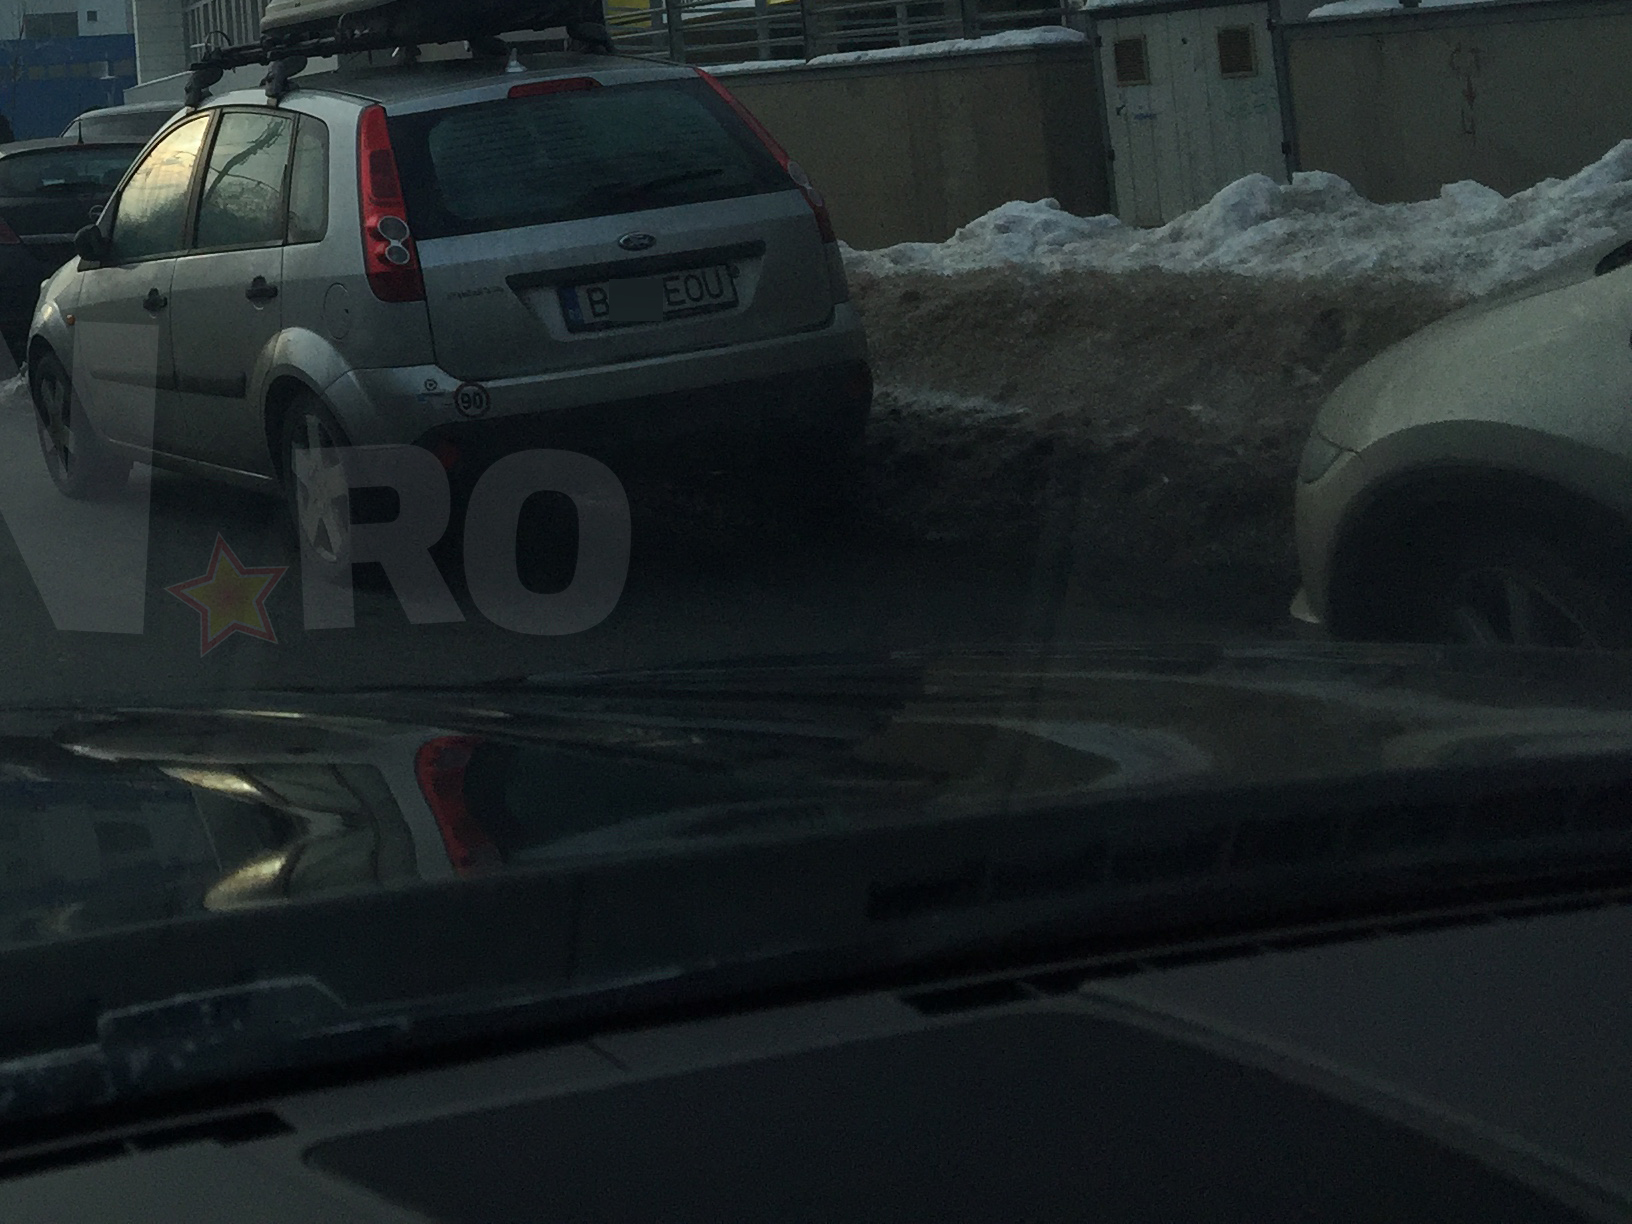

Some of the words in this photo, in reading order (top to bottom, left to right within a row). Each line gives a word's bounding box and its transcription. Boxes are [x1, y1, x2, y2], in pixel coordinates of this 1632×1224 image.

[587, 286, 609, 318] B
[663, 263, 724, 307] EOU
[460, 391, 483, 411] 90
